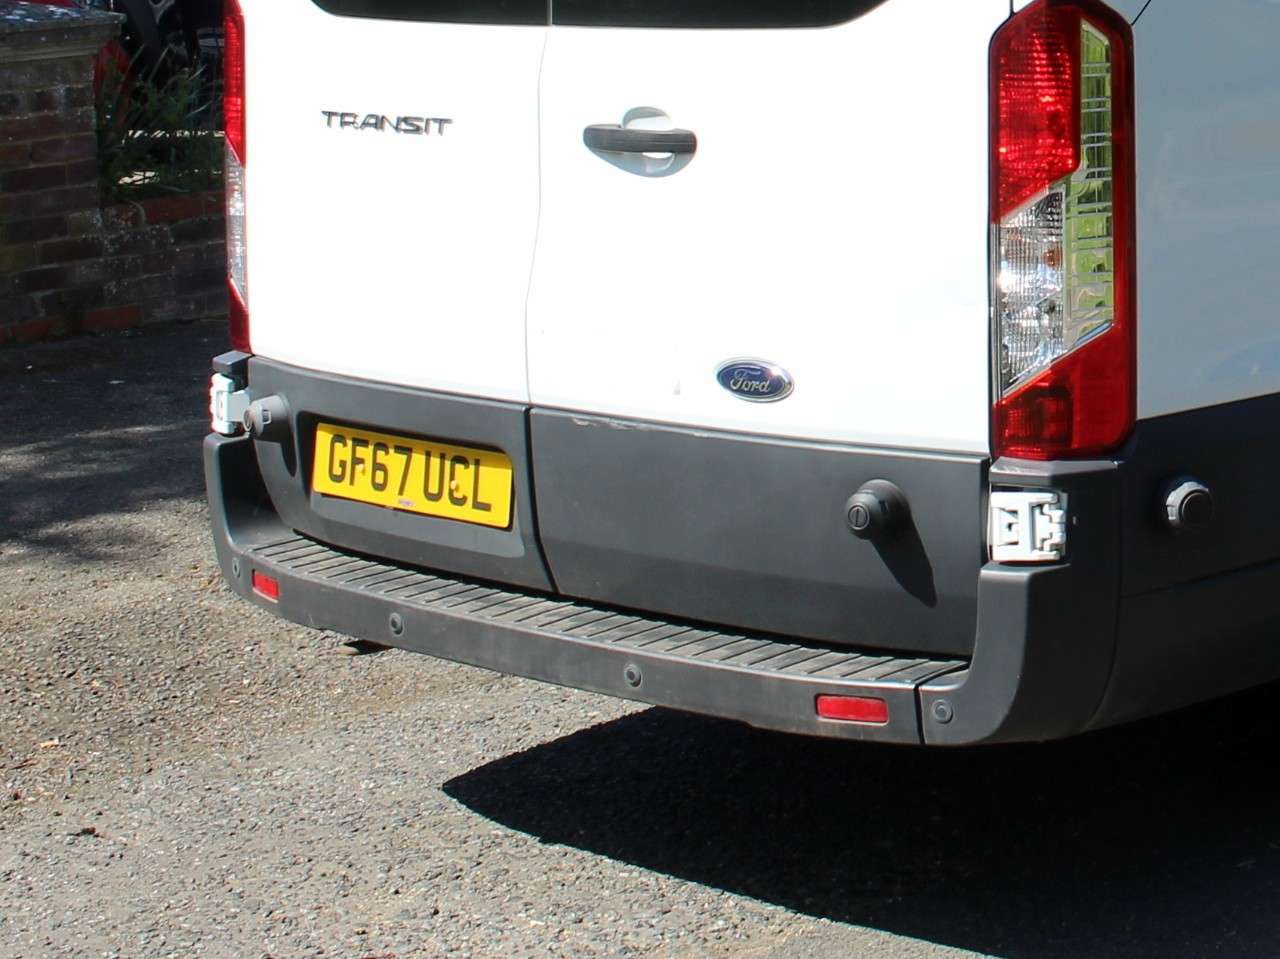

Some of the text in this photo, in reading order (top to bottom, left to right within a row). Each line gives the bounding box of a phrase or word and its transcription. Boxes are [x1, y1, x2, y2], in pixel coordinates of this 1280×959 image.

[321, 110, 453, 136] TRANSIT
[729, 368, 771, 393] Ford
[328, 434, 492, 512] GF67 UCL
